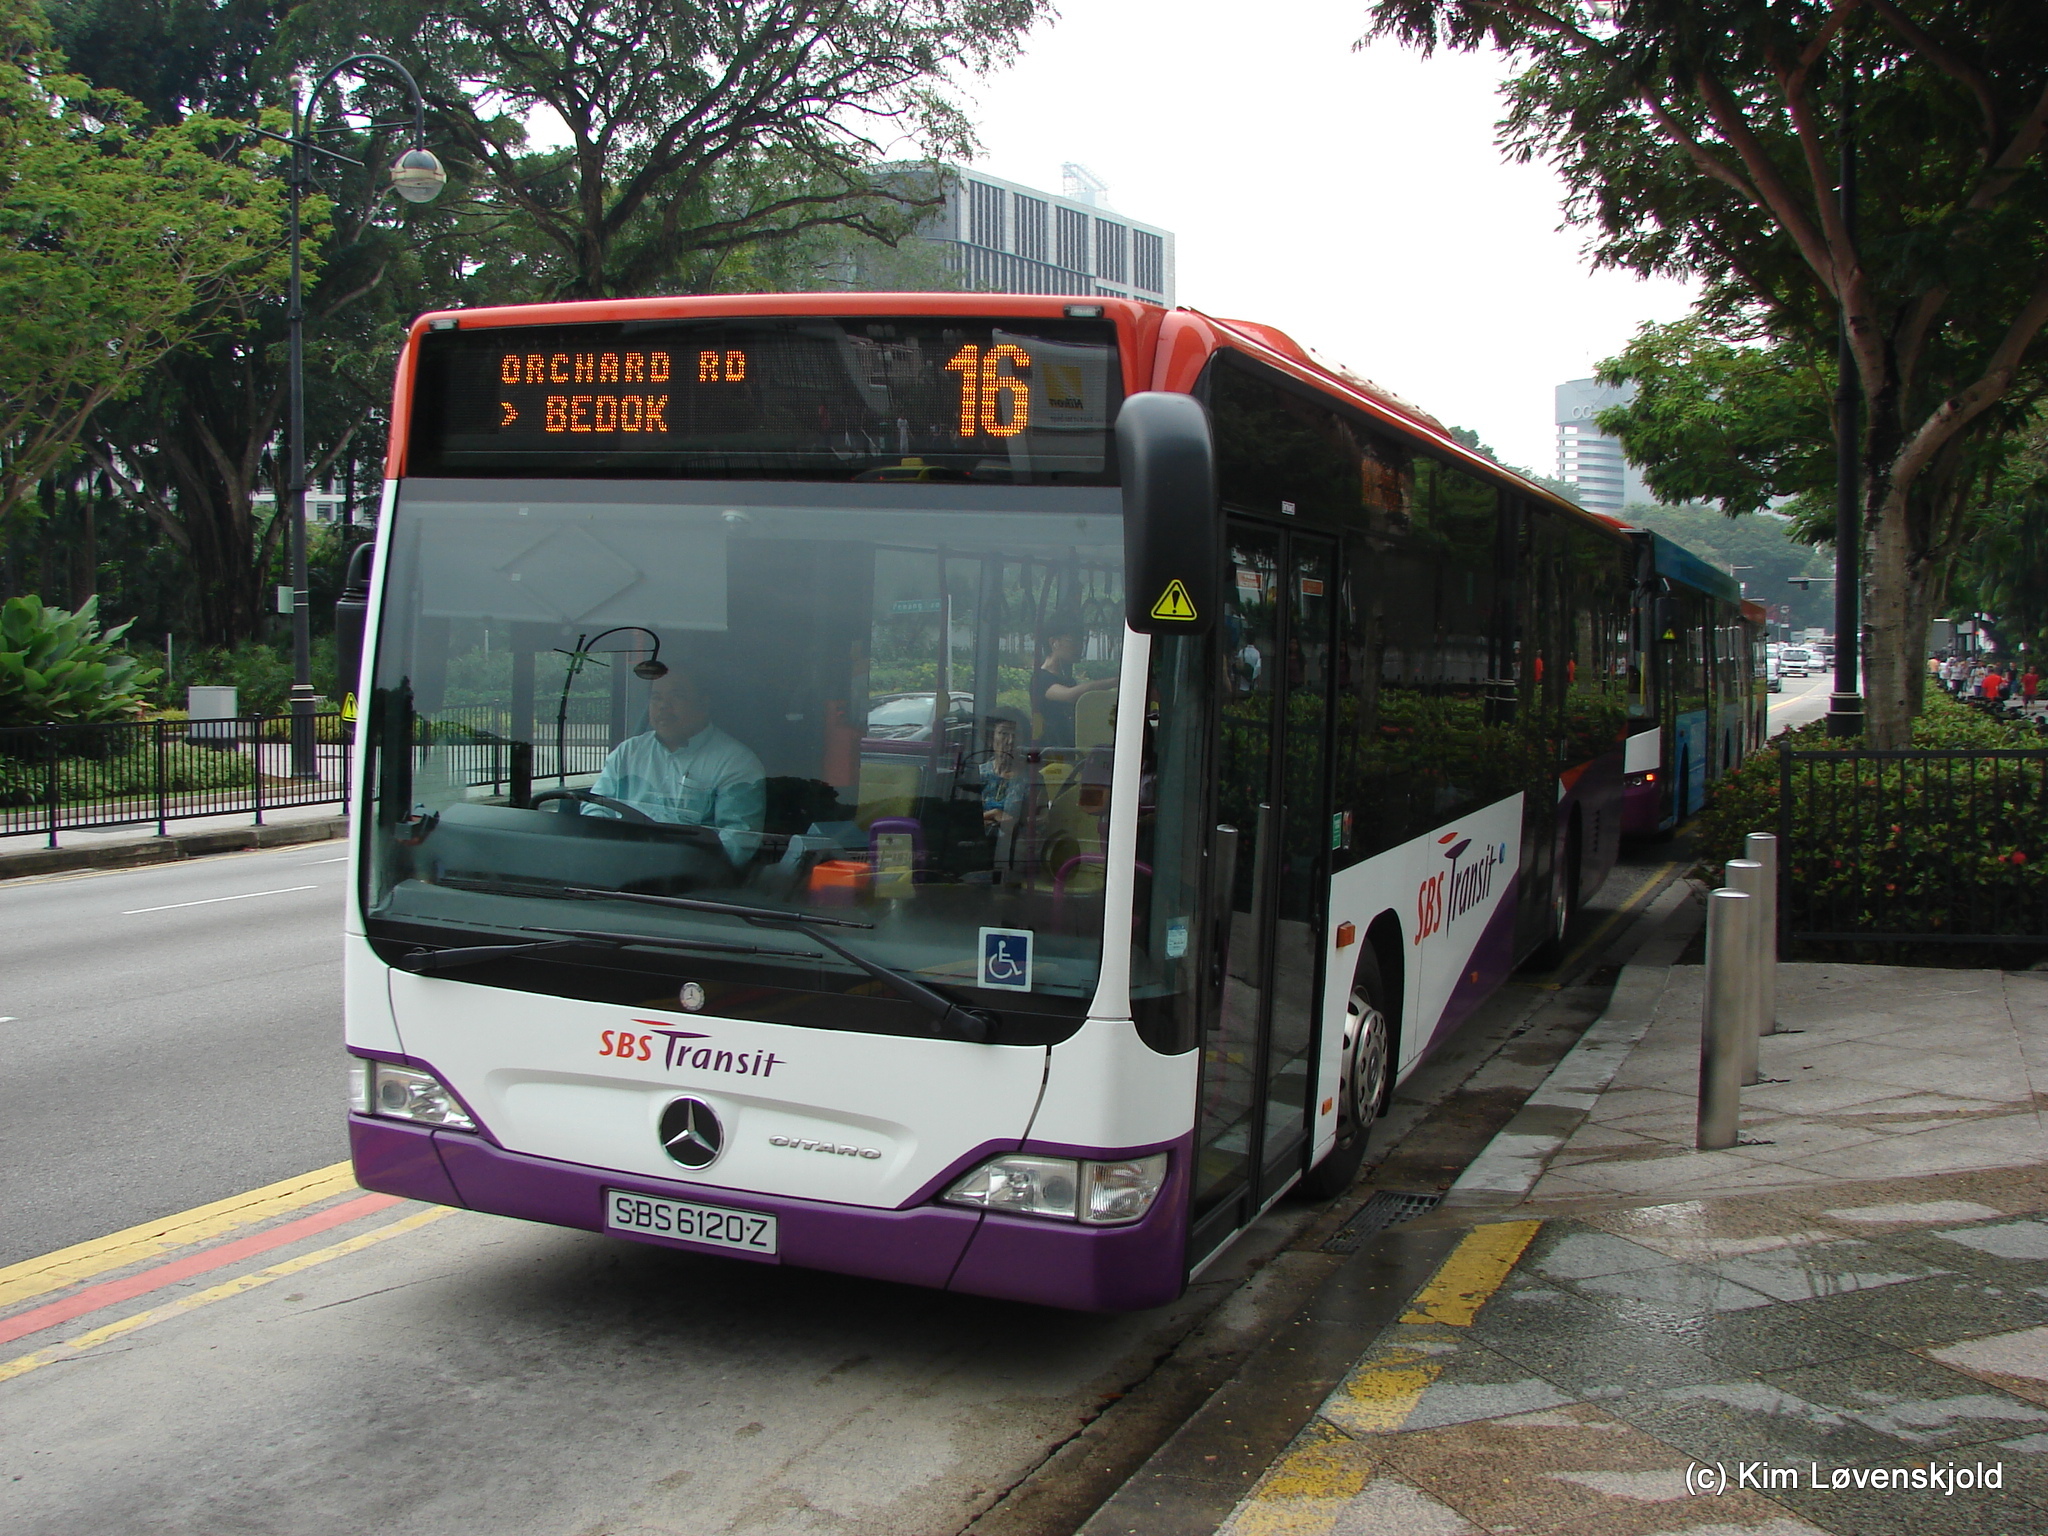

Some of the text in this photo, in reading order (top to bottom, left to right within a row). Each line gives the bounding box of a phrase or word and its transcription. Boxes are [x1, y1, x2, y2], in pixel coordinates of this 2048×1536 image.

[501, 350, 746, 384] ORCHARD RD
[944, 343, 1031, 438] 16
[545, 394, 668, 433] BEDOK
[1414, 838, 1497, 946] SBS Transit
[599, 1028, 787, 1078] SBS Transit
[768, 1133, 882, 1161] CITARO
[615, 1196, 769, 1248] SBS6120Z
